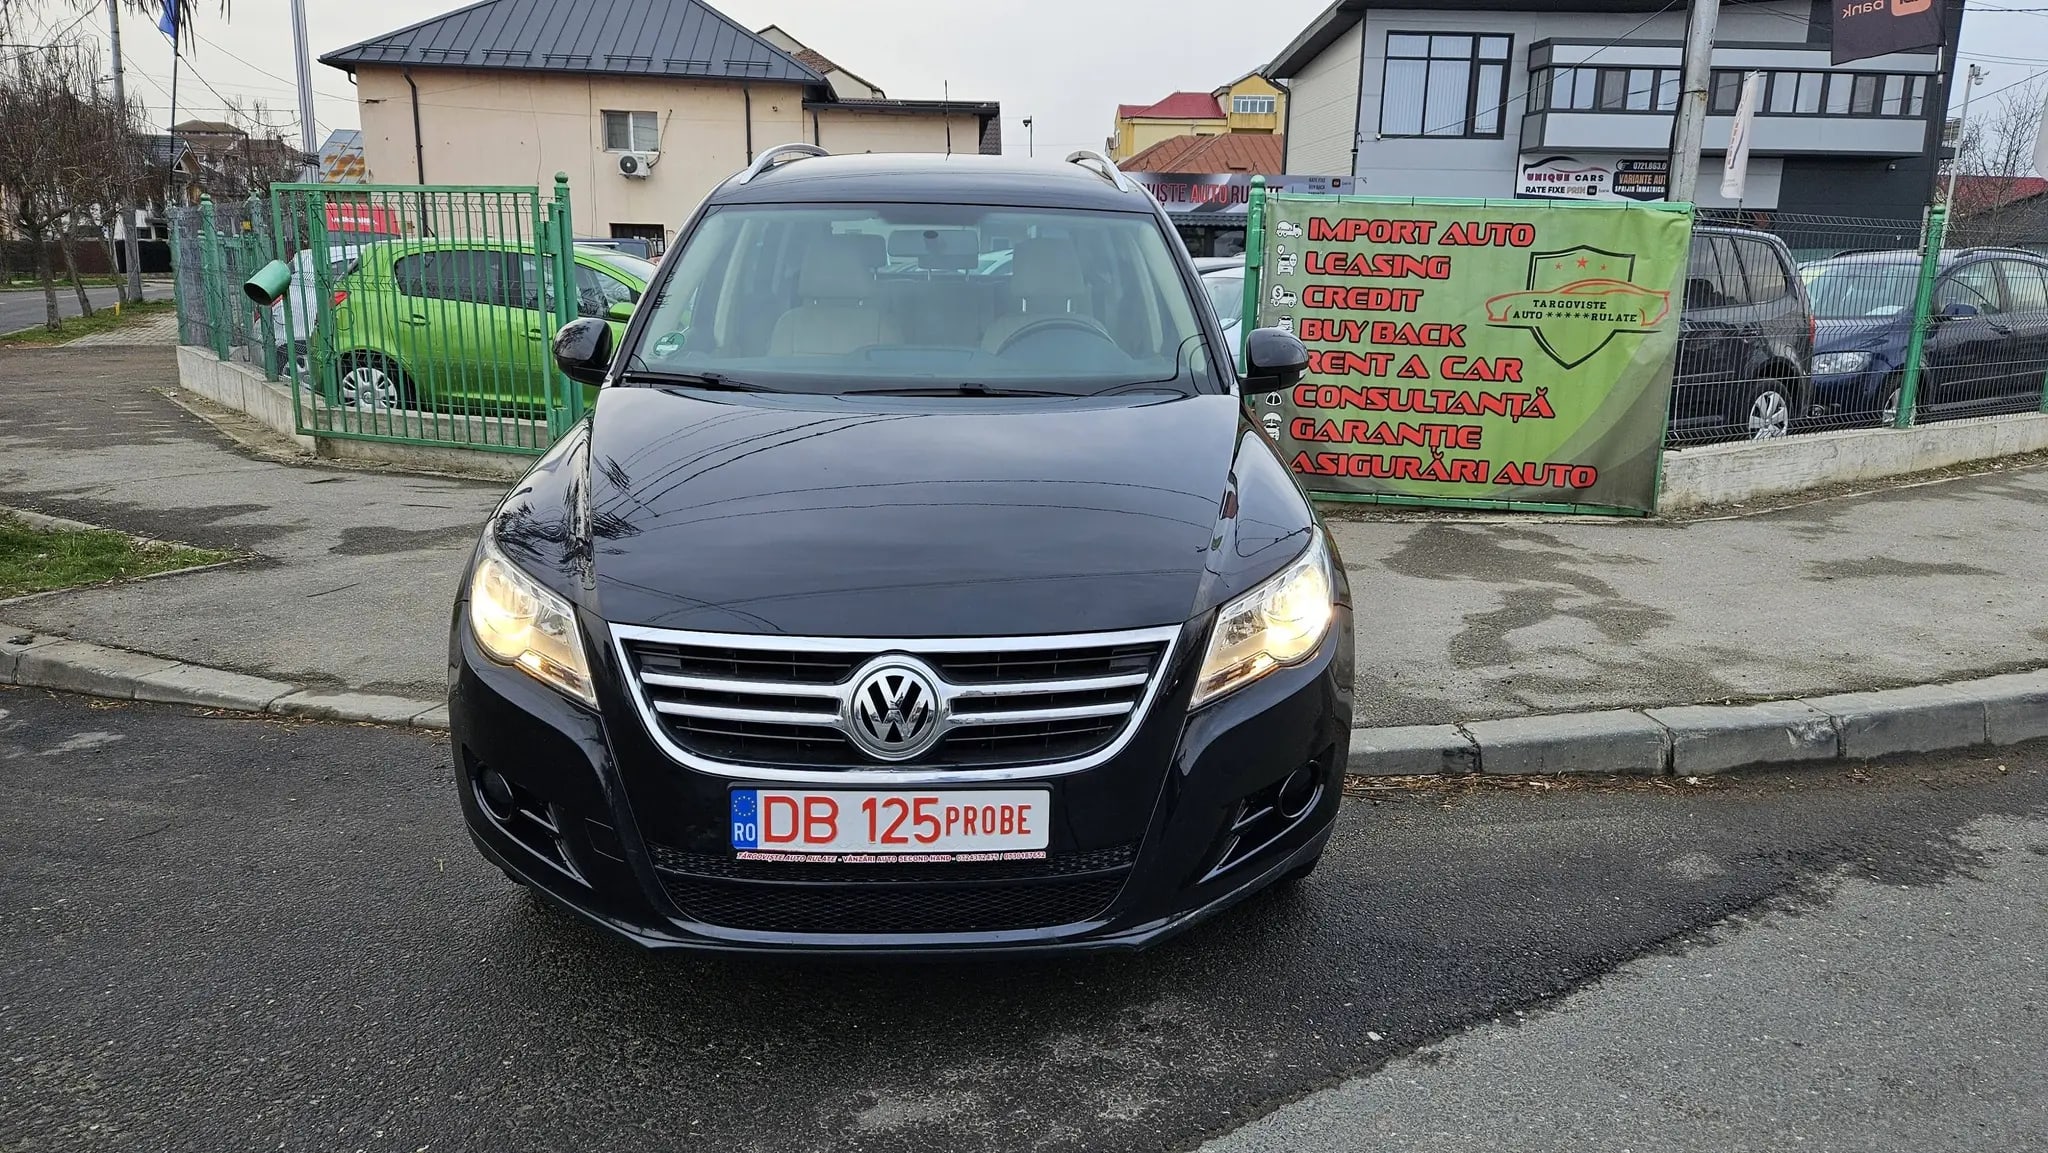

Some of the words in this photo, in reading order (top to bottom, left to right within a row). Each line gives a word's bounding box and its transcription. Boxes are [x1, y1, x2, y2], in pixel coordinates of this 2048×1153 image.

[1526, 173, 1570, 183] UNIQUE
[1575, 174, 1604, 182] CARS
[1547, 186, 1565, 194] FIXE
[1566, 186, 1586, 194] PRIN
[1619, 173, 1652, 184] VARIANTE
[1190, 183, 1228, 204] AUTO
[1308, 217, 1437, 245] IMPORT
[1439, 222, 1536, 247] AUTO
[1305, 251, 1451, 279] LEASING
[1302, 285, 1424, 312] CREDIT
[1533, 299, 1607, 310] TARGOVISTE
[1513, 310, 1543, 319] AUTO
[1591, 313, 1637, 322] RULATE
[1300, 318, 1369, 343] BUY
[1371, 320, 1467, 347] BACK
[1307, 350, 1394, 378] RENT
[1397, 354, 1430, 378] A
[1440, 356, 1523, 382] CAR
[1293, 384, 1555, 423] CONSULTANȚĂ
[1290, 417, 1482, 453] GARANȚIE
[1290, 450, 1488, 483] ASIGURĂRI
[1493, 461, 1597, 489] AUTO
[734, 822, 756, 842] RO
[763, 796, 839, 844] DB
[861, 797, 942, 845] 125
[944, 804, 1032, 837] PROBE
[783, 854, 806, 862] AUTO
[806, 854, 837, 863] RULATE
[877, 855, 897, 863] AUTO
